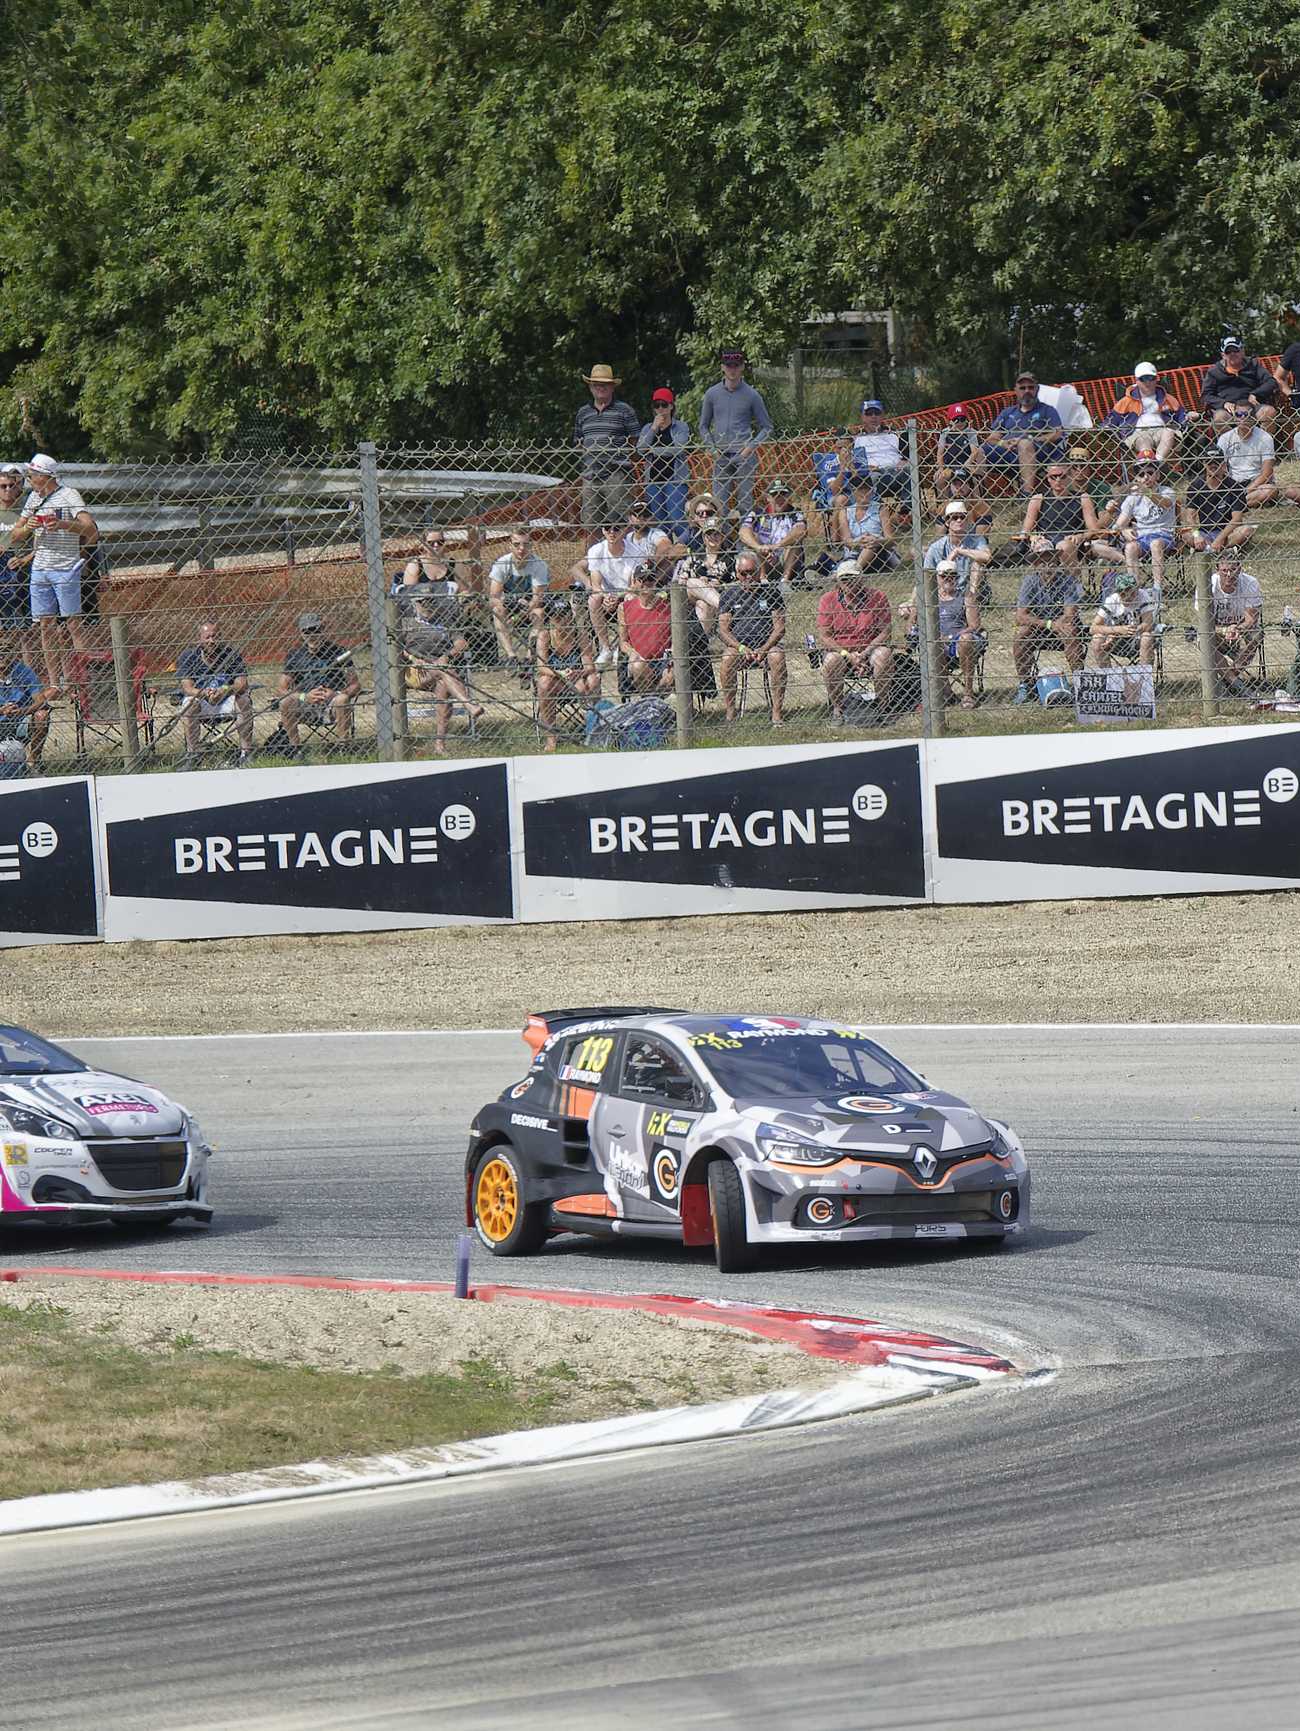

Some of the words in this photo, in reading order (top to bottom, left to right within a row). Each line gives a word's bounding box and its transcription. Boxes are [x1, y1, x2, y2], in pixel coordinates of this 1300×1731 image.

[589, 807, 850, 854] BRETAGNE
[1002, 789, 1261, 836] BRETAGNE
[174, 827, 438, 874] BRETAGNE
[576, 1035, 614, 1073] 113
[709, 1037, 744, 1051] 113
[726, 1028, 829, 1040] RAYMOND
